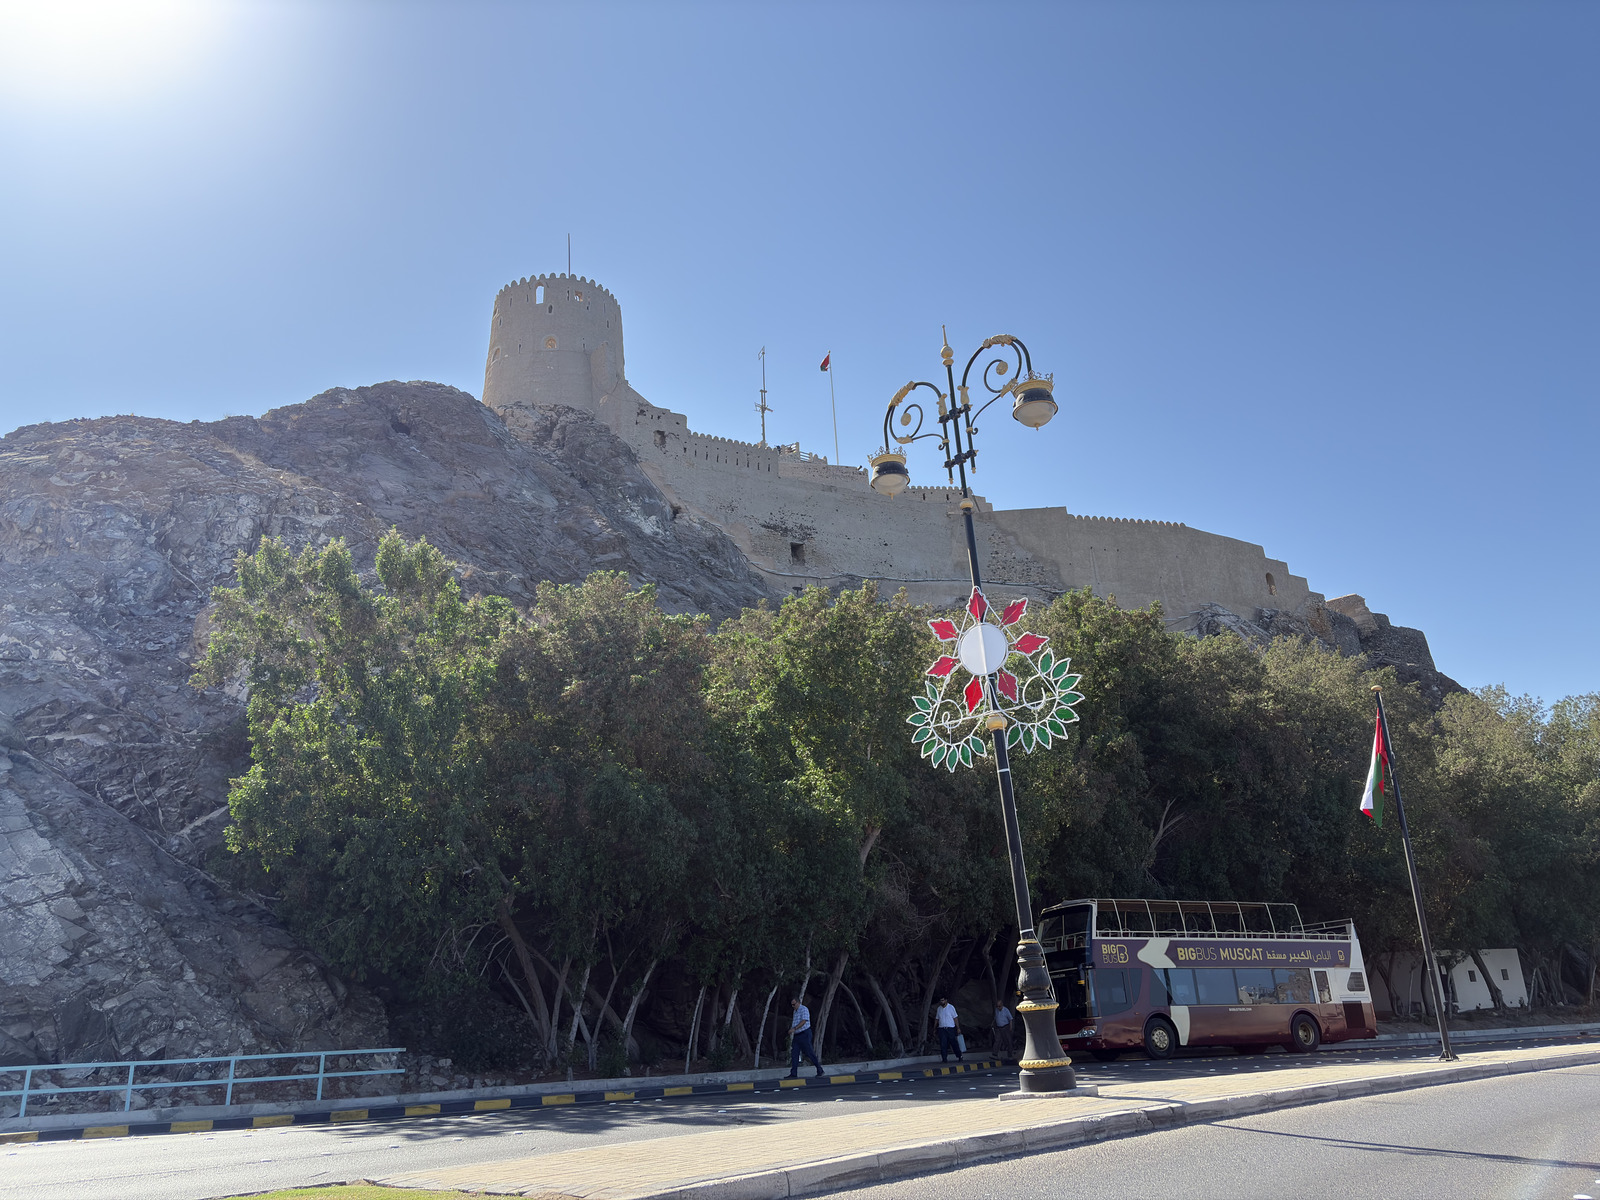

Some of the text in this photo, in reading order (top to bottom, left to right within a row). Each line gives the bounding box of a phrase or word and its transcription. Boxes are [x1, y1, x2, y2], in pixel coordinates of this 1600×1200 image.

[1101, 944, 1117, 954] BIG
[1219, 947, 1263, 961] MUSCAT
[1103, 954, 1119, 964] BUS
[1266, 949, 1332, 963] الباص الكبير مسقط
